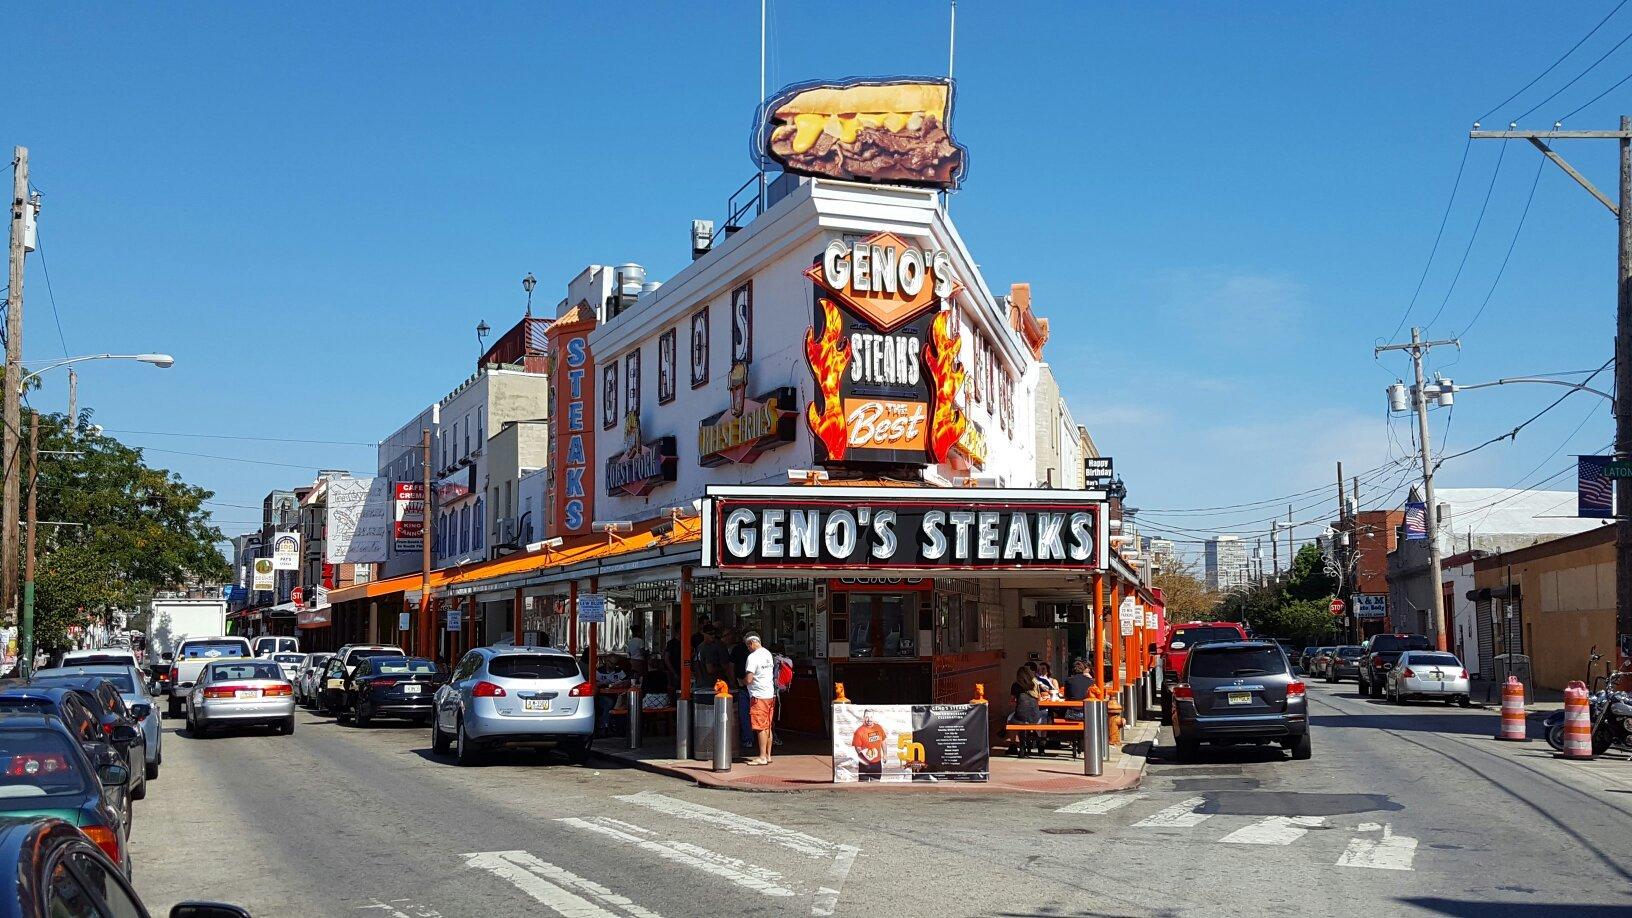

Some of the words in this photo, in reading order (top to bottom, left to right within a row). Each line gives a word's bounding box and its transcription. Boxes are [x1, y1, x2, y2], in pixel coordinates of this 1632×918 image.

[824, 239, 951, 297] GENO'S
[850, 333, 920, 386] STEAKS
[565, 337, 587, 530] STEAKS
[847, 402, 925, 447] Best
[632, 449, 658, 481] PORK
[1085, 468, 1112, 476] Birthday
[1088, 459, 1108, 467] Happy
[725, 507, 897, 560] GENO'S
[922, 509, 1094, 561] STEAKS
